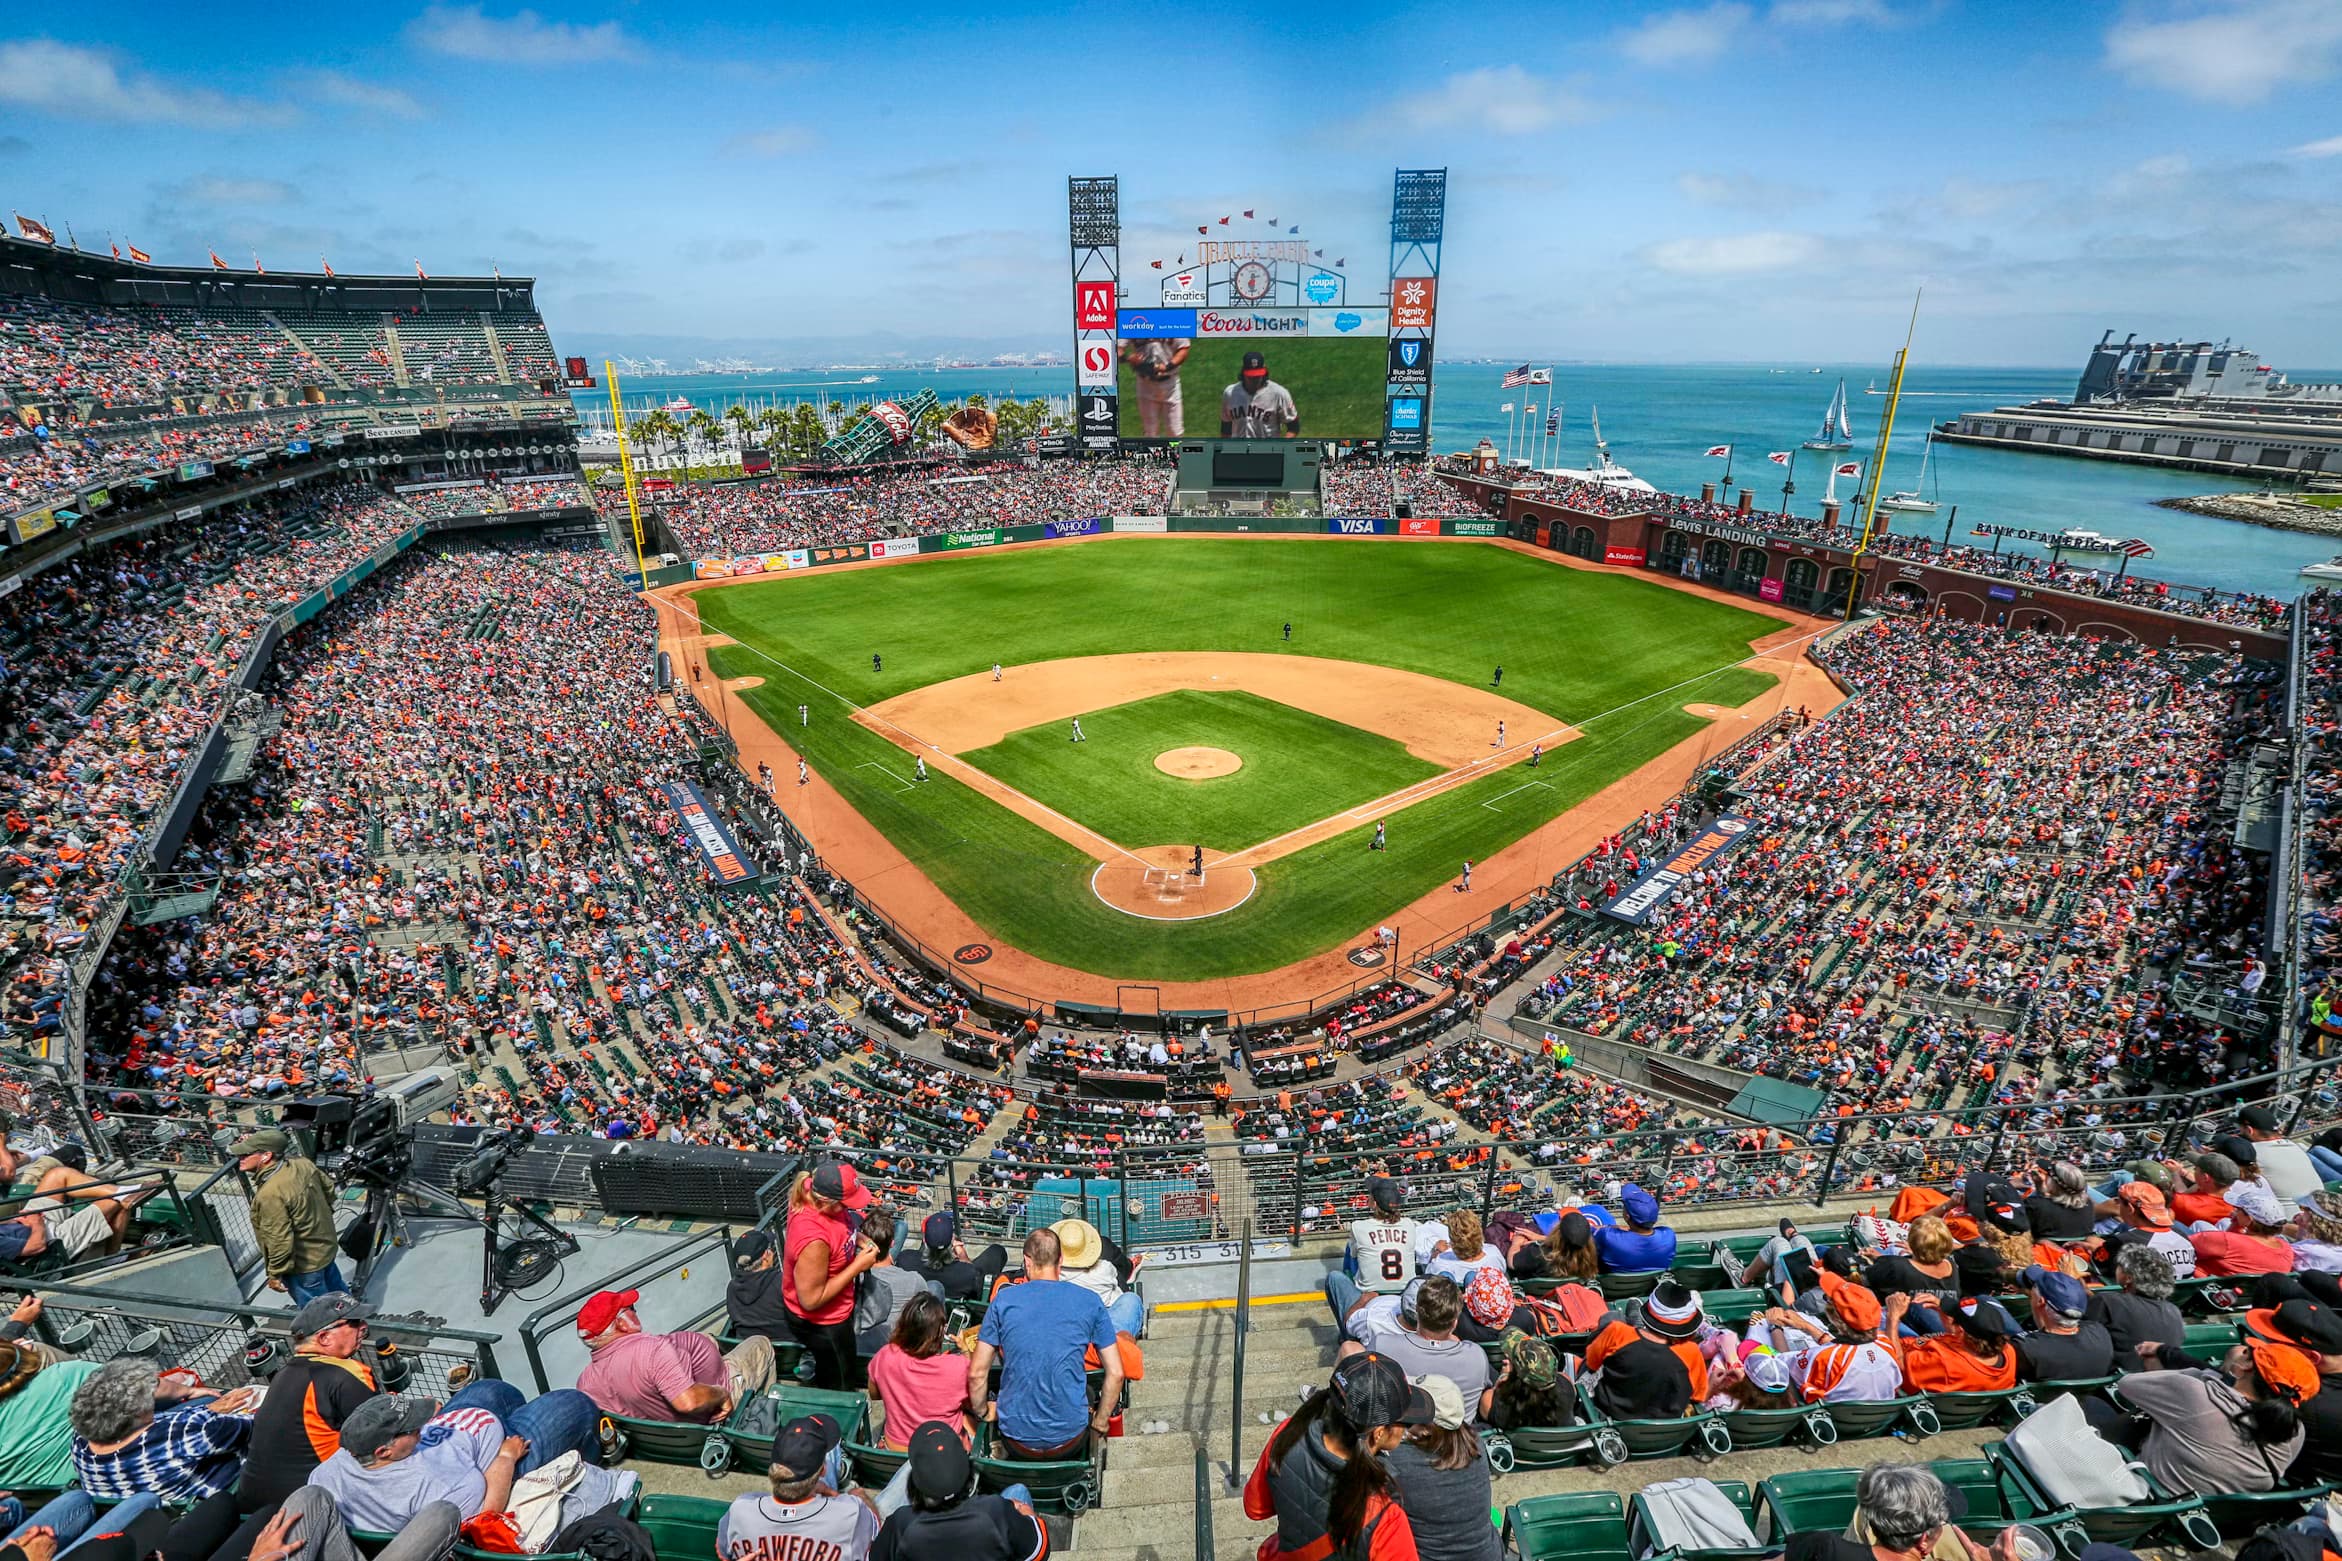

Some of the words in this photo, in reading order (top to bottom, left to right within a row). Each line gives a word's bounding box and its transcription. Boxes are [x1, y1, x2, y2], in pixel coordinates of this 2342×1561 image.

[1309, 279, 1335, 288] coupa
[1163, 290, 1206, 301] Fanatics
[1086, 313, 1108, 323] Adobe
[1397, 307, 1428, 317] Dignity
[1121, 321, 1155, 332] workday
[1201, 312, 1253, 332] Coors
[1254, 318, 1299, 331] LIGHT
[633, 450, 738, 472] nuveen
[484, 514, 508, 523] xfinity
[1054, 519, 1091, 534] YAHOO!
[1337, 520, 1374, 533] VISA
[1455, 523, 1496, 532] BIOFREEZE
[958, 531, 996, 544] National
[1705, 525, 1767, 548] LANDING
[1976, 523, 2015, 537] BANK
[2018, 528, 2037, 541] OF
[2038, 532, 2112, 553] AMERICA
[887, 543, 917, 552] TOYOTA
[685, 812, 711, 827] SAN
[692, 822, 732, 857] FRANCISCO
[1695, 832, 1731, 851] PARK
[713, 854, 747, 880] GIANTS
[1665, 848, 1712, 874] ORACLE
[1653, 870, 1682, 884] TO
[1611, 879, 1671, 917] WELCOME
[1368, 1228, 1408, 1245] PENCE
[1165, 1245, 1202, 1261] 315
[1380, 1248, 1404, 1281] 8
[730, 1534, 843, 1561] CRAWFORD
